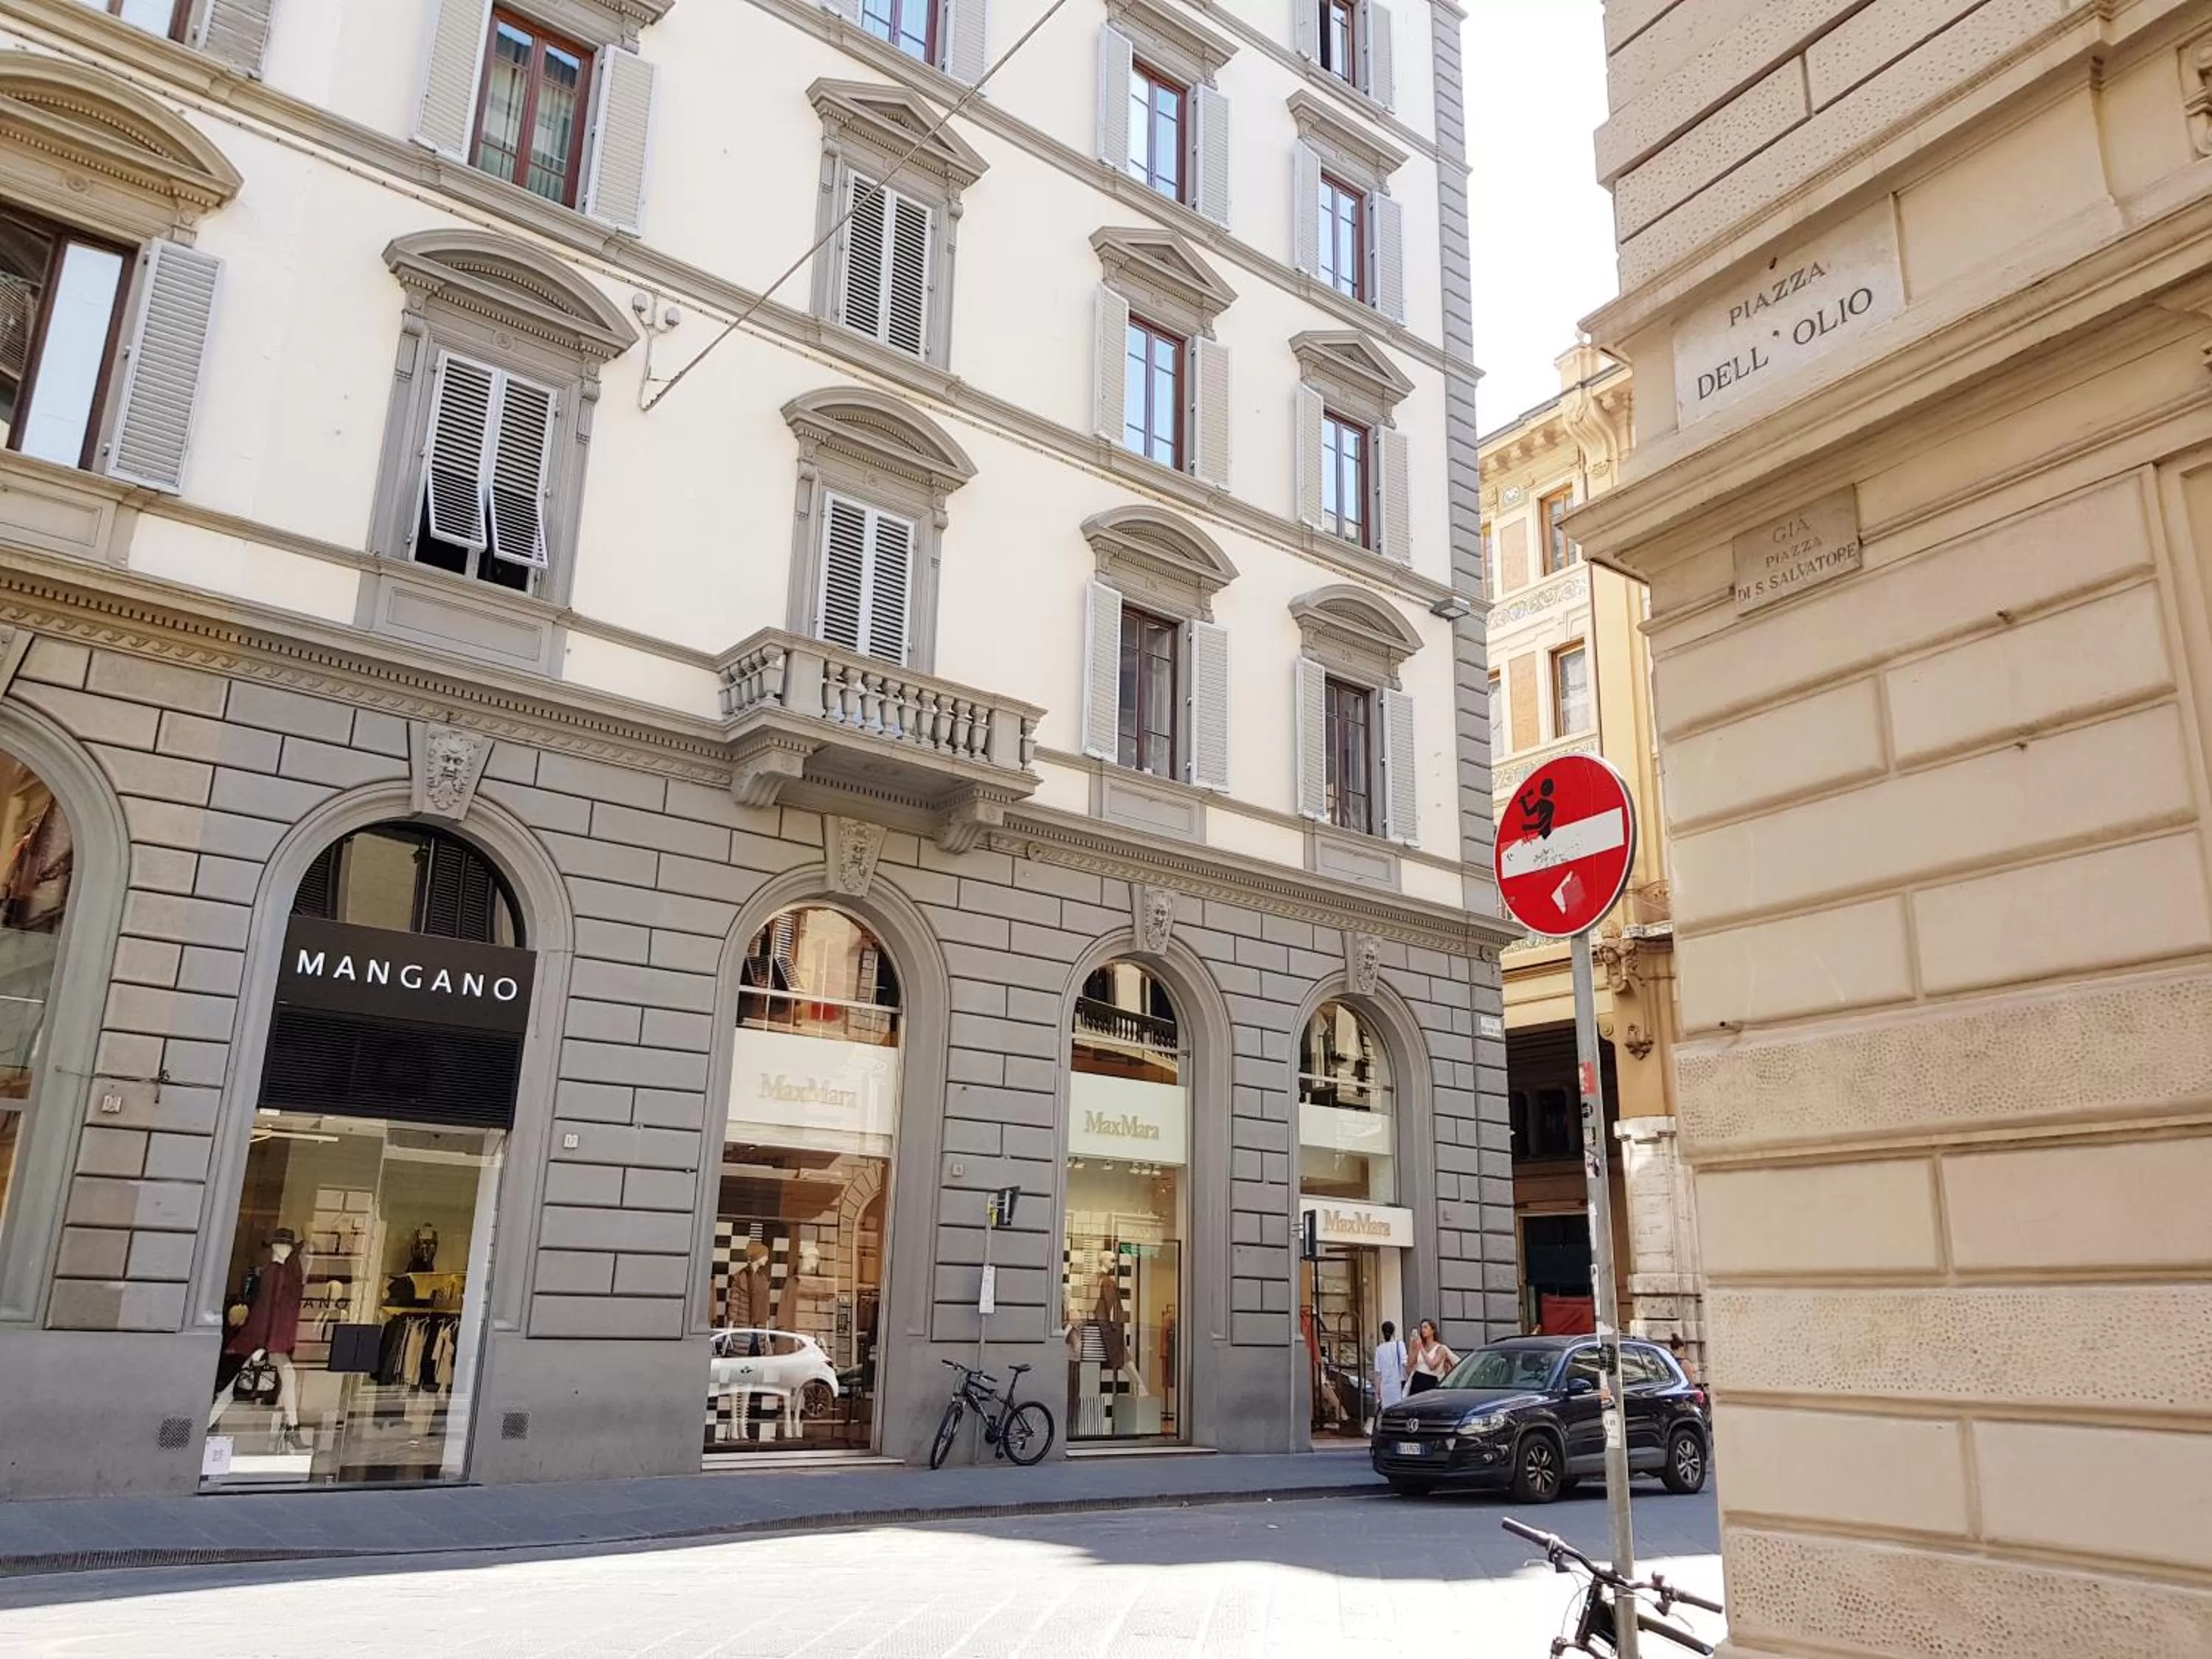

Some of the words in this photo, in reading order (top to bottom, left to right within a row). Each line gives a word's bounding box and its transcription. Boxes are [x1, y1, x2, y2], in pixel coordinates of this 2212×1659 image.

[1729, 262, 1826, 327] PIAZZA
[1737, 585, 1751, 602] DI
[1769, 542, 1857, 589] SALVATORE
[1766, 536, 1823, 568] PIAZZA
[296, 949, 518, 1001] MANGANO
[1082, 1110, 1160, 1140] MaxMara
[1323, 1209, 1391, 1237] MaxMara
